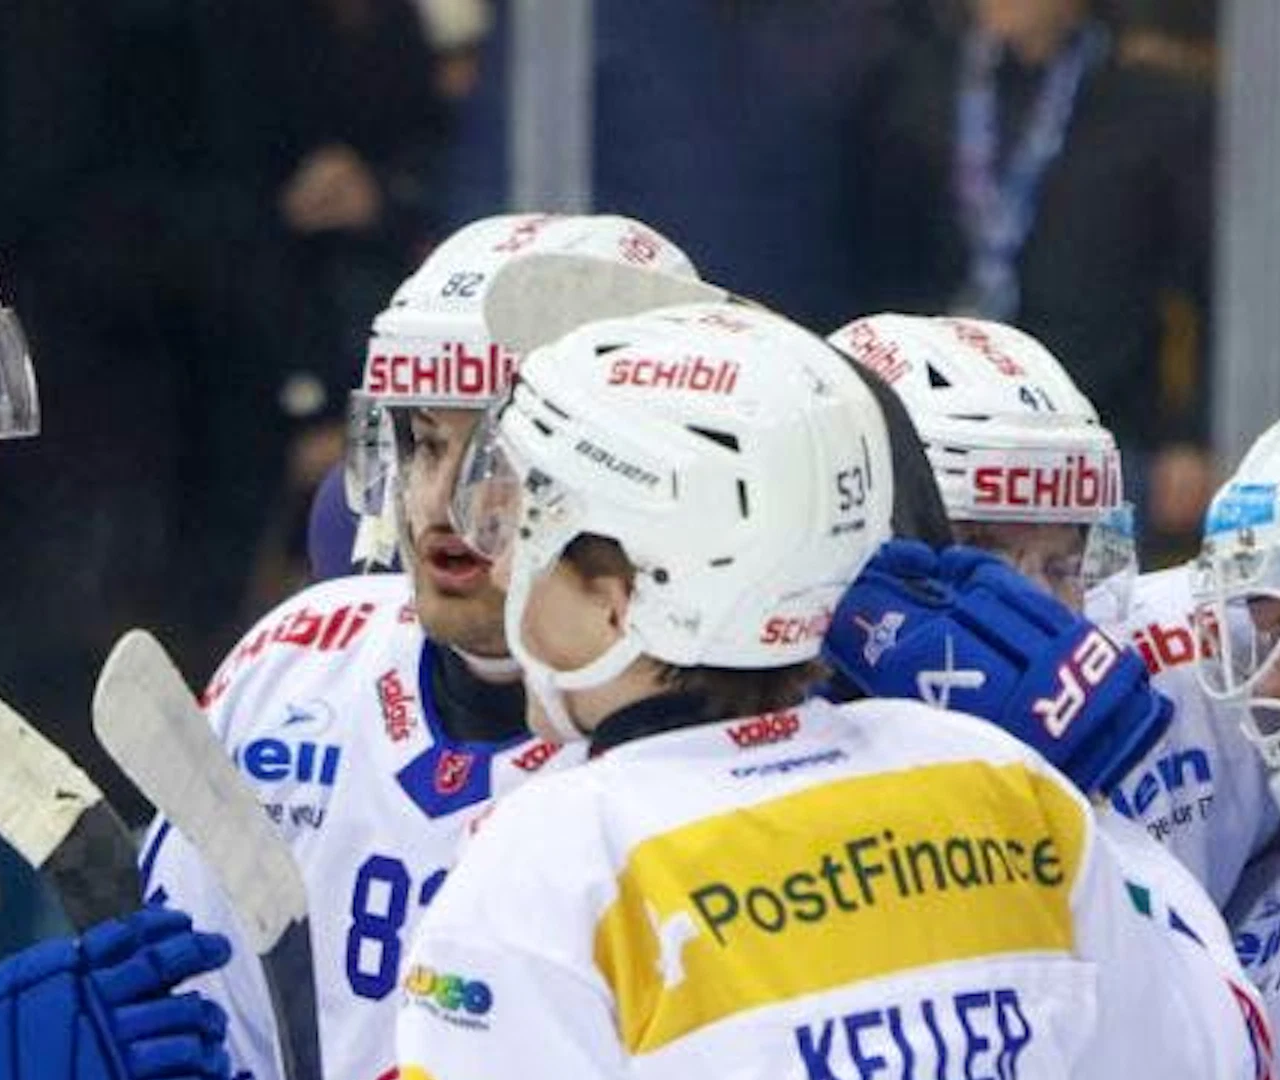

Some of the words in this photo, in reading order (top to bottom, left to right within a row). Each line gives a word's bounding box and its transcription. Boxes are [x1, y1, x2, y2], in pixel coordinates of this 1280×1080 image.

[441, 271, 485, 299] 82
[836, 465, 866, 511] 53
[346, 853, 451, 1001] 8
[689, 829, 1065, 948] PostFinance
